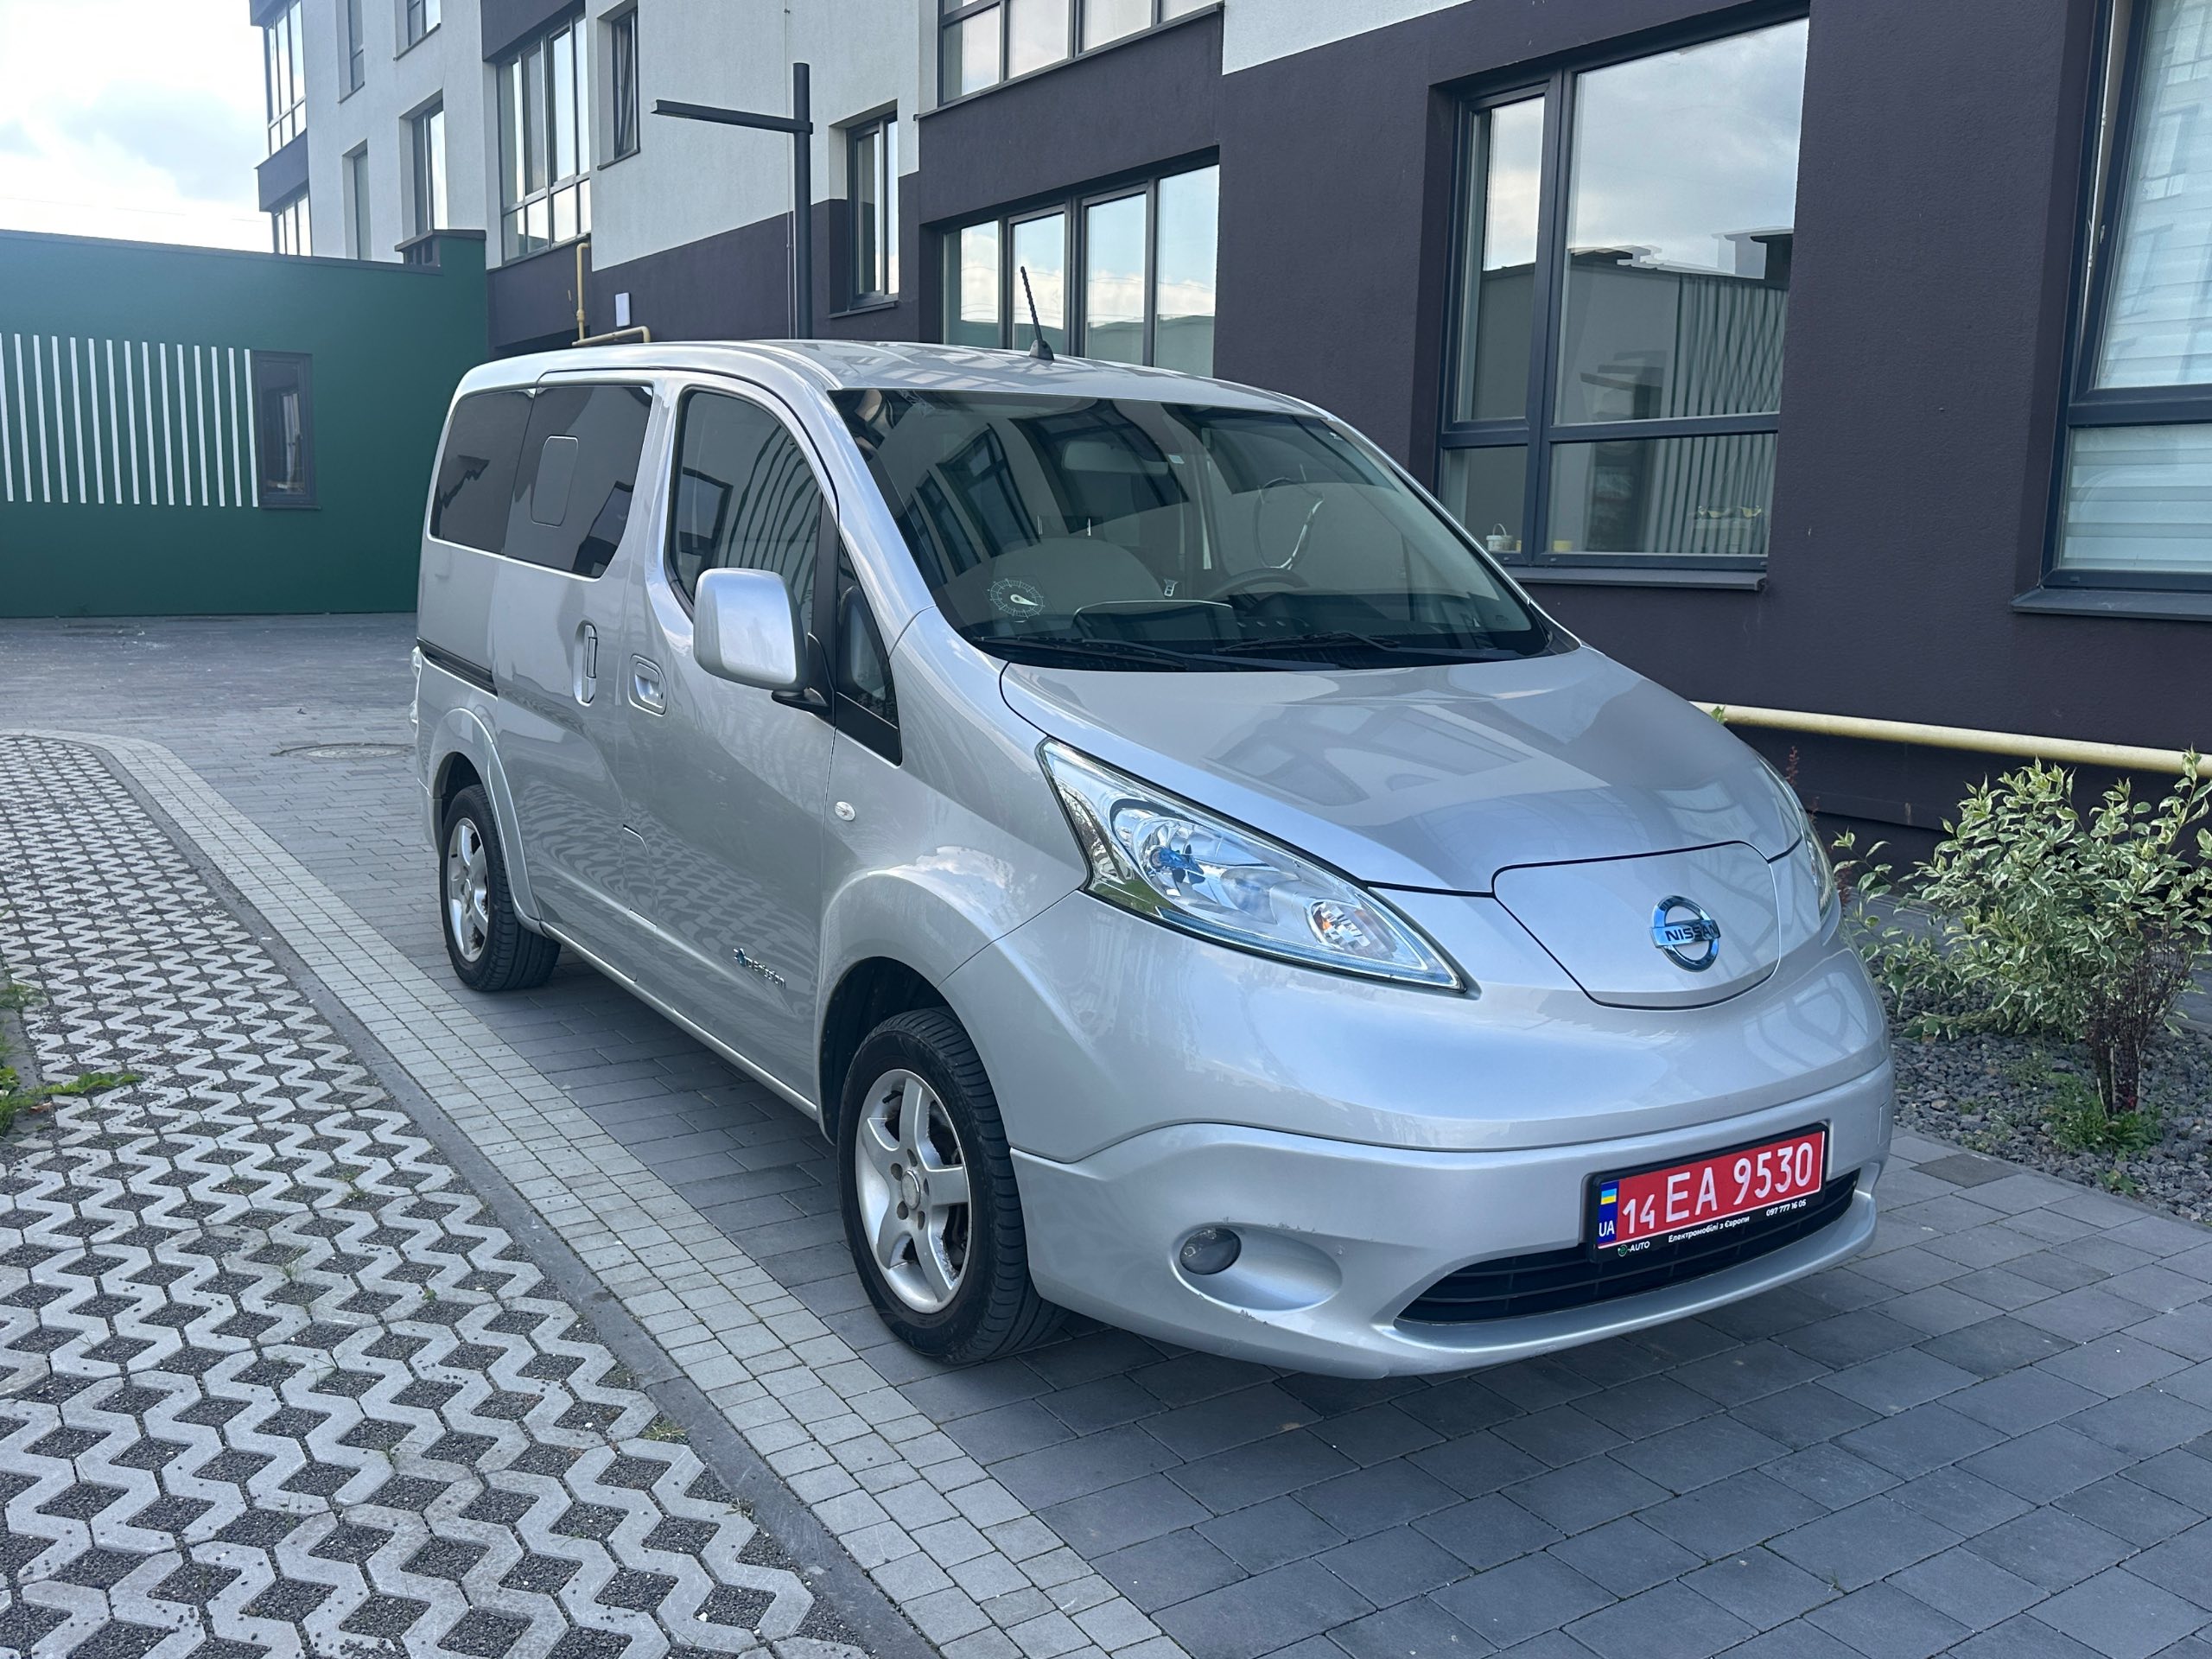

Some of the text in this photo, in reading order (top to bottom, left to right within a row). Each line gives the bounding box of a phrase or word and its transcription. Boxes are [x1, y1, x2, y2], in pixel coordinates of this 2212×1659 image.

[1664, 924, 1719, 942] NISSAN
[1623, 1141, 1814, 1234] 14 EA 9530
[1765, 1206, 1779, 1217] 097
[1778, 1203, 1790, 1213] 777
[1798, 1198, 1807, 1208] 05
[1599, 1220, 1615, 1237] UA
[1668, 1223, 1719, 1243] Електромобілі
[1724, 1216, 1751, 1228] Європи
